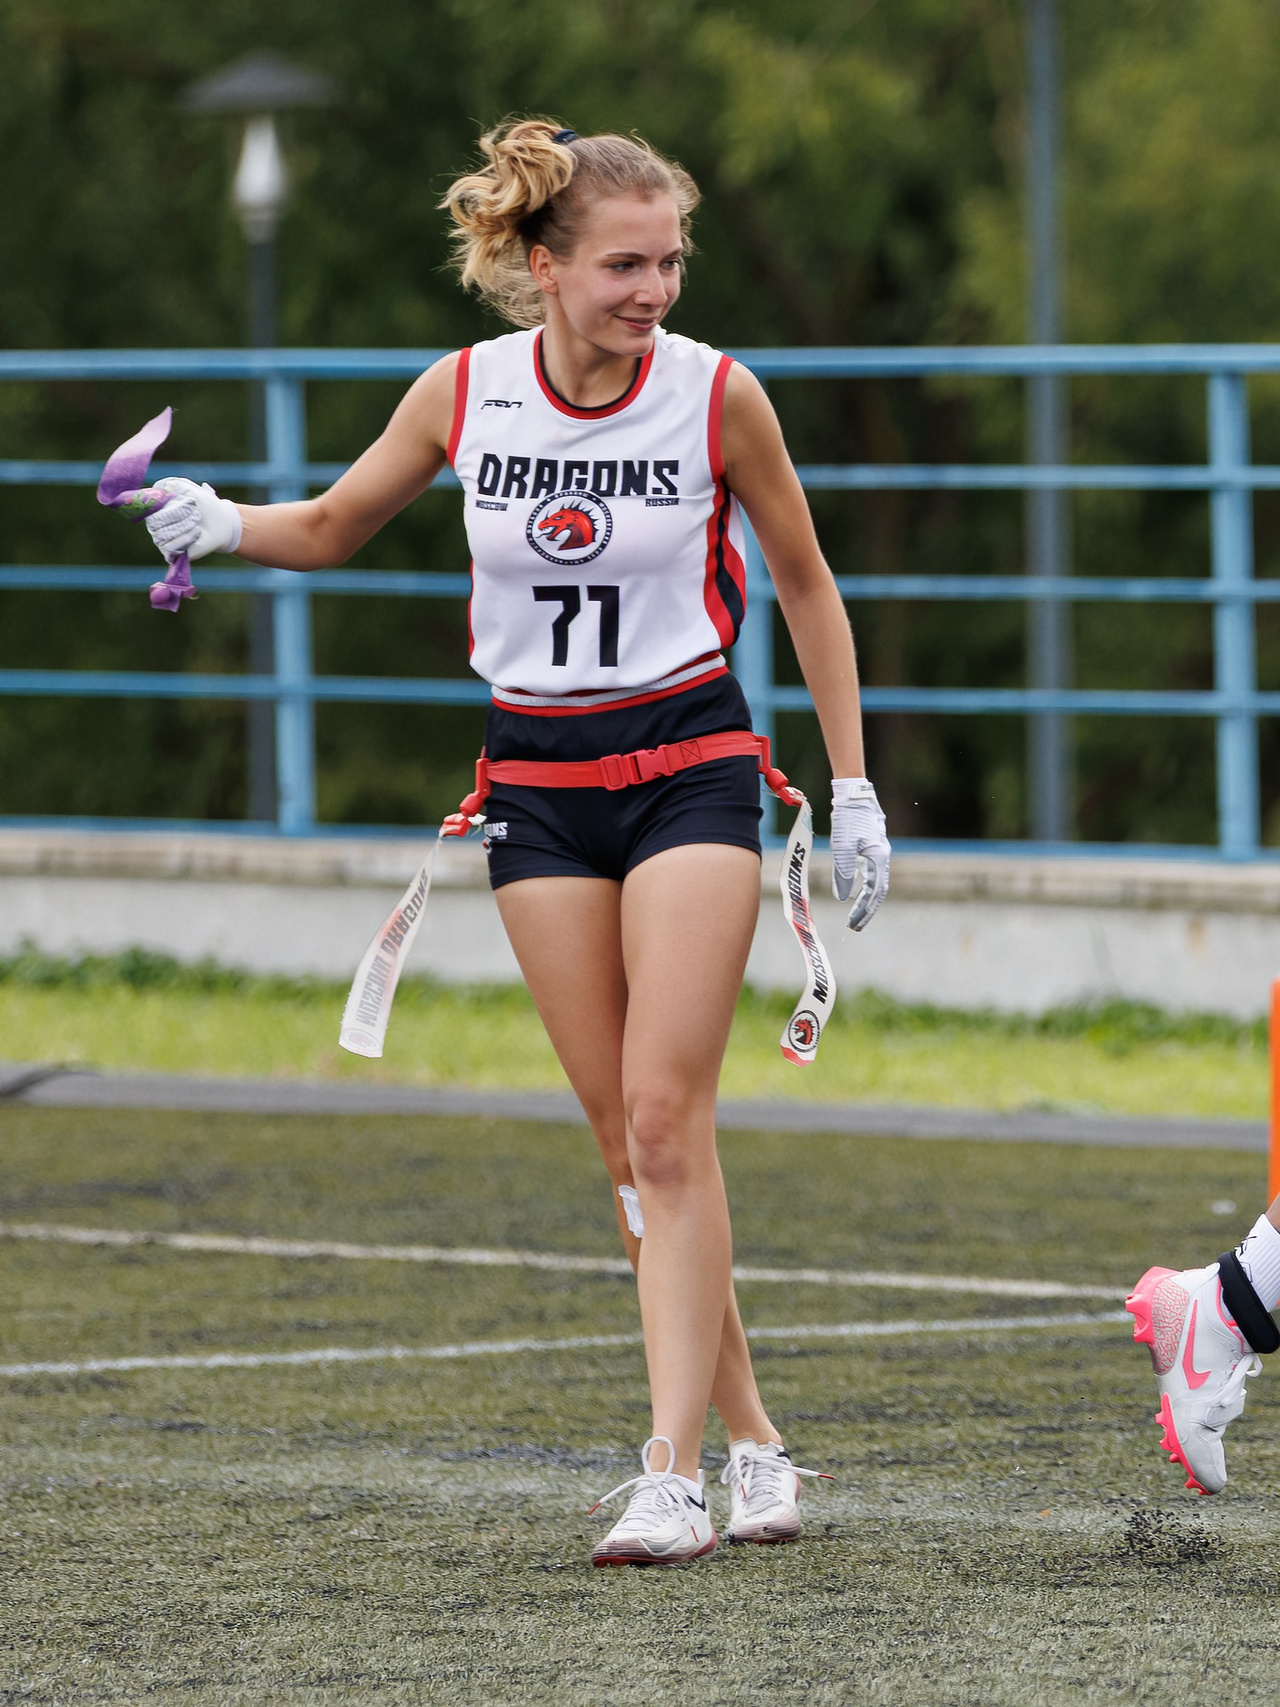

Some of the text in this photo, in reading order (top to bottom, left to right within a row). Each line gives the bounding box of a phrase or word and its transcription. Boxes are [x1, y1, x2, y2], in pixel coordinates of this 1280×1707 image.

[476, 452, 680, 499] DRAGONS
[531, 584, 620, 667] 71
[788, 840, 829, 1005] MOSCOW DRAGONS
